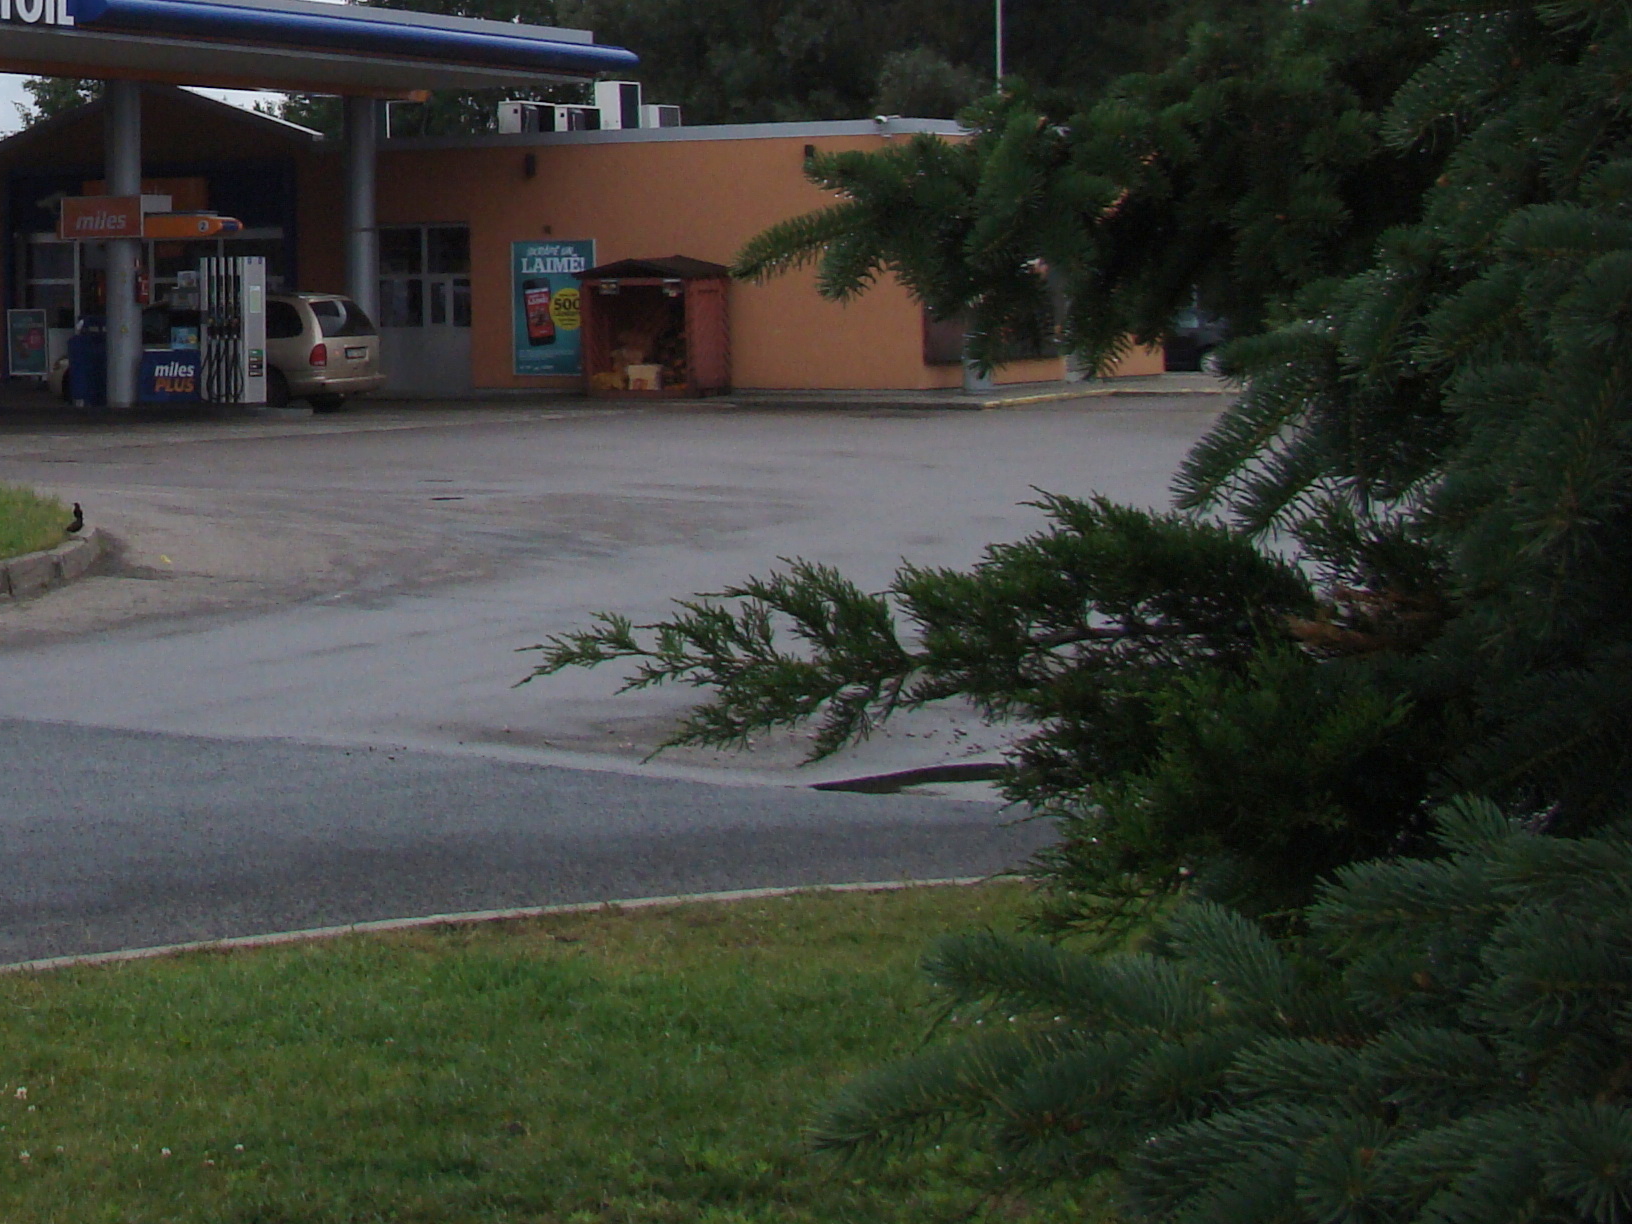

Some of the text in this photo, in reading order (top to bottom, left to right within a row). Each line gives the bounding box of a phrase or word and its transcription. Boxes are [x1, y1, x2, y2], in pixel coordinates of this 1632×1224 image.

[75, 210, 127, 230] miles
[154, 361, 195, 377] miles
[154, 378, 195, 392] PLUS
